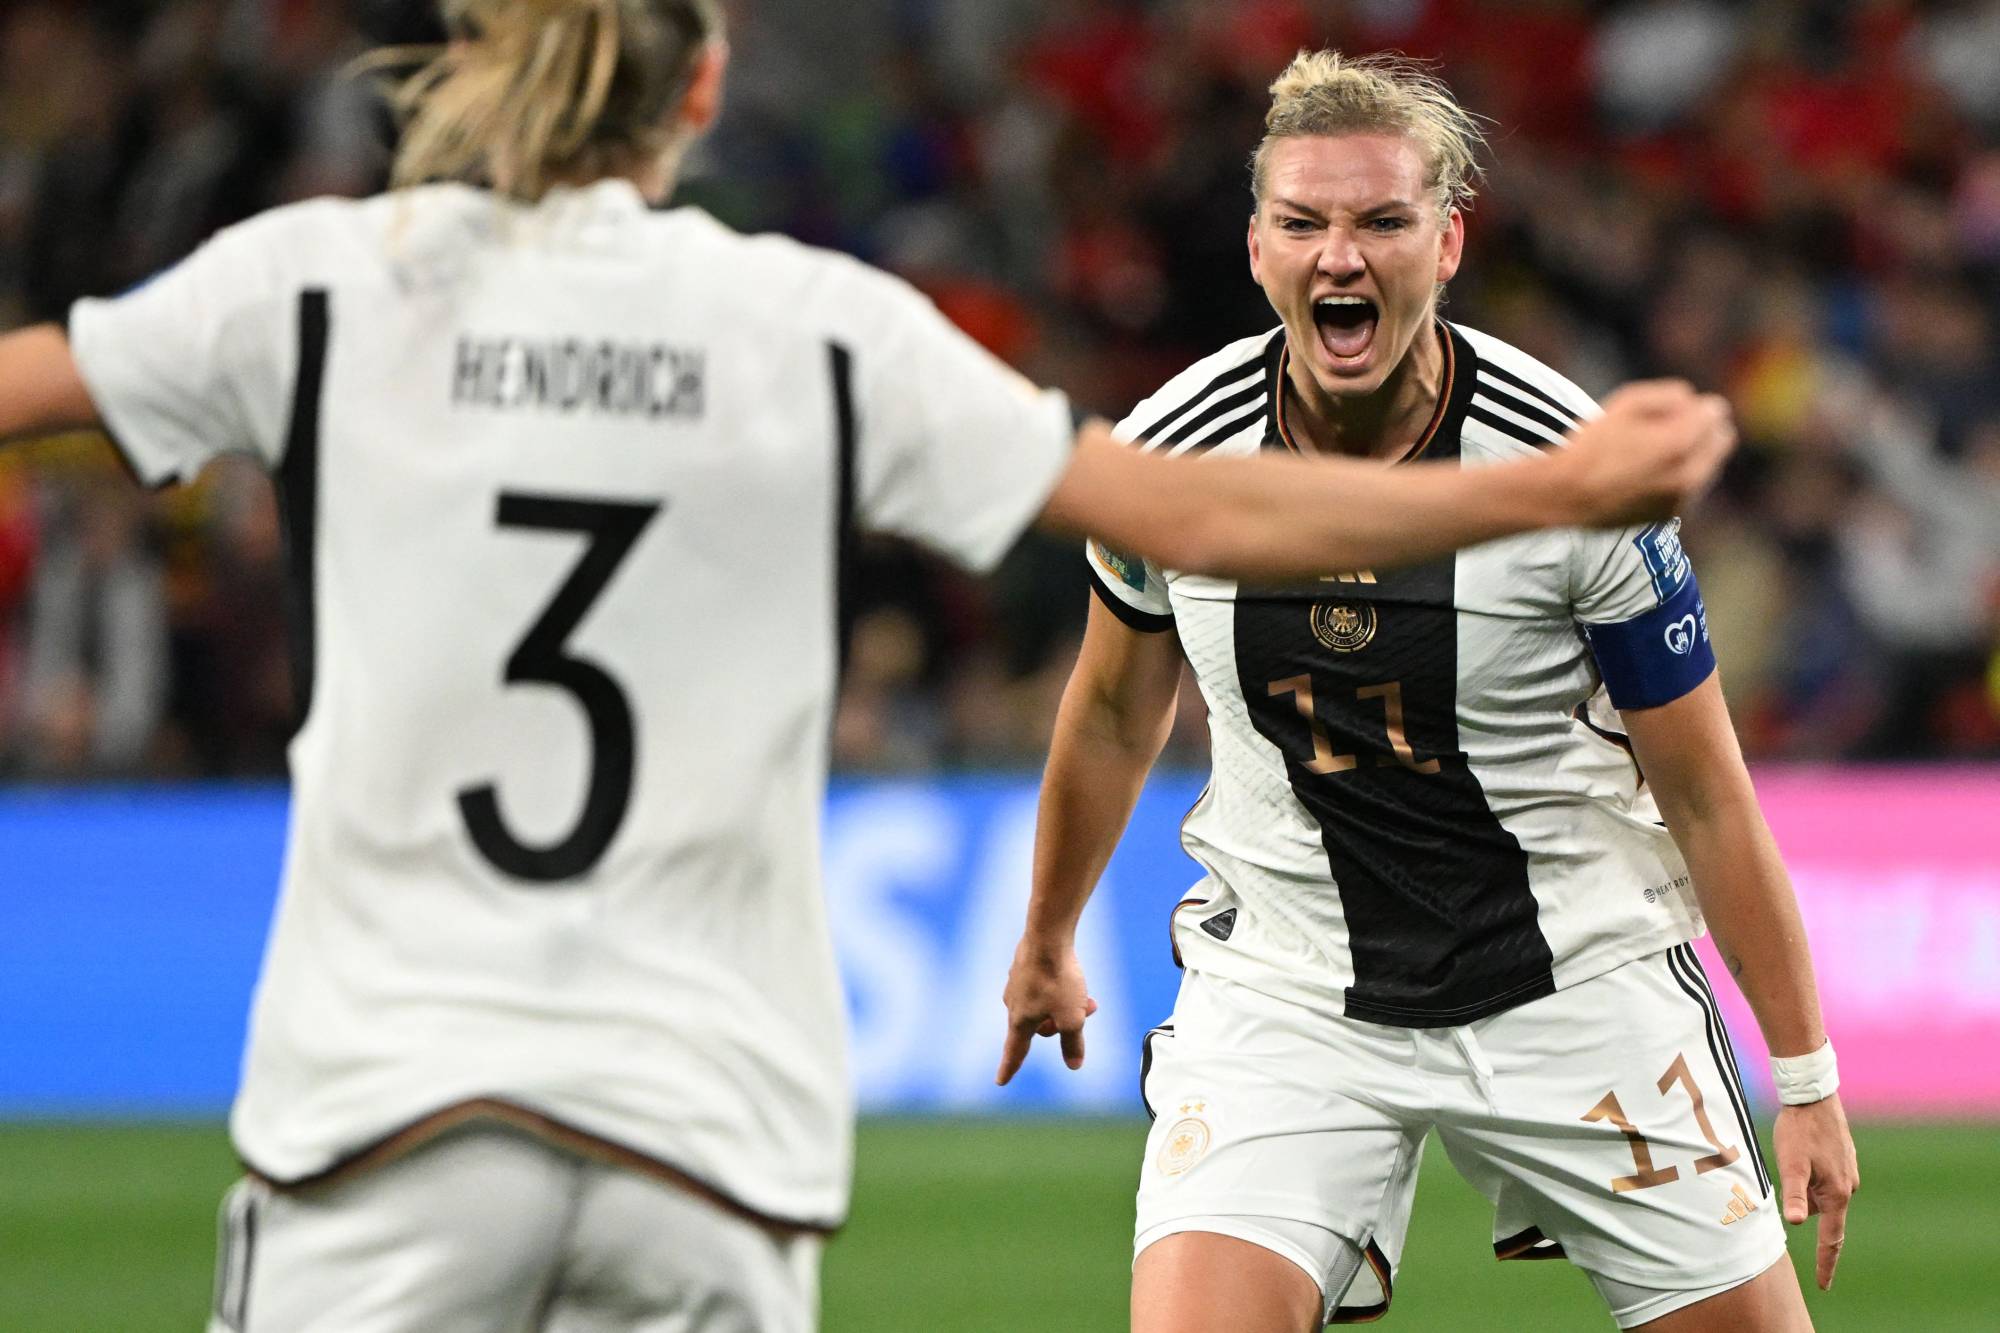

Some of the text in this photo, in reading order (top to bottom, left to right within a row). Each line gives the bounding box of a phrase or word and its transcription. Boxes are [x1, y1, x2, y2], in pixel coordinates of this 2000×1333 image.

[453, 337, 706, 417] HENDRICH
[457, 490, 664, 884] 3
[1268, 673, 1441, 775] 11
[1580, 1051, 1741, 1193] 11
